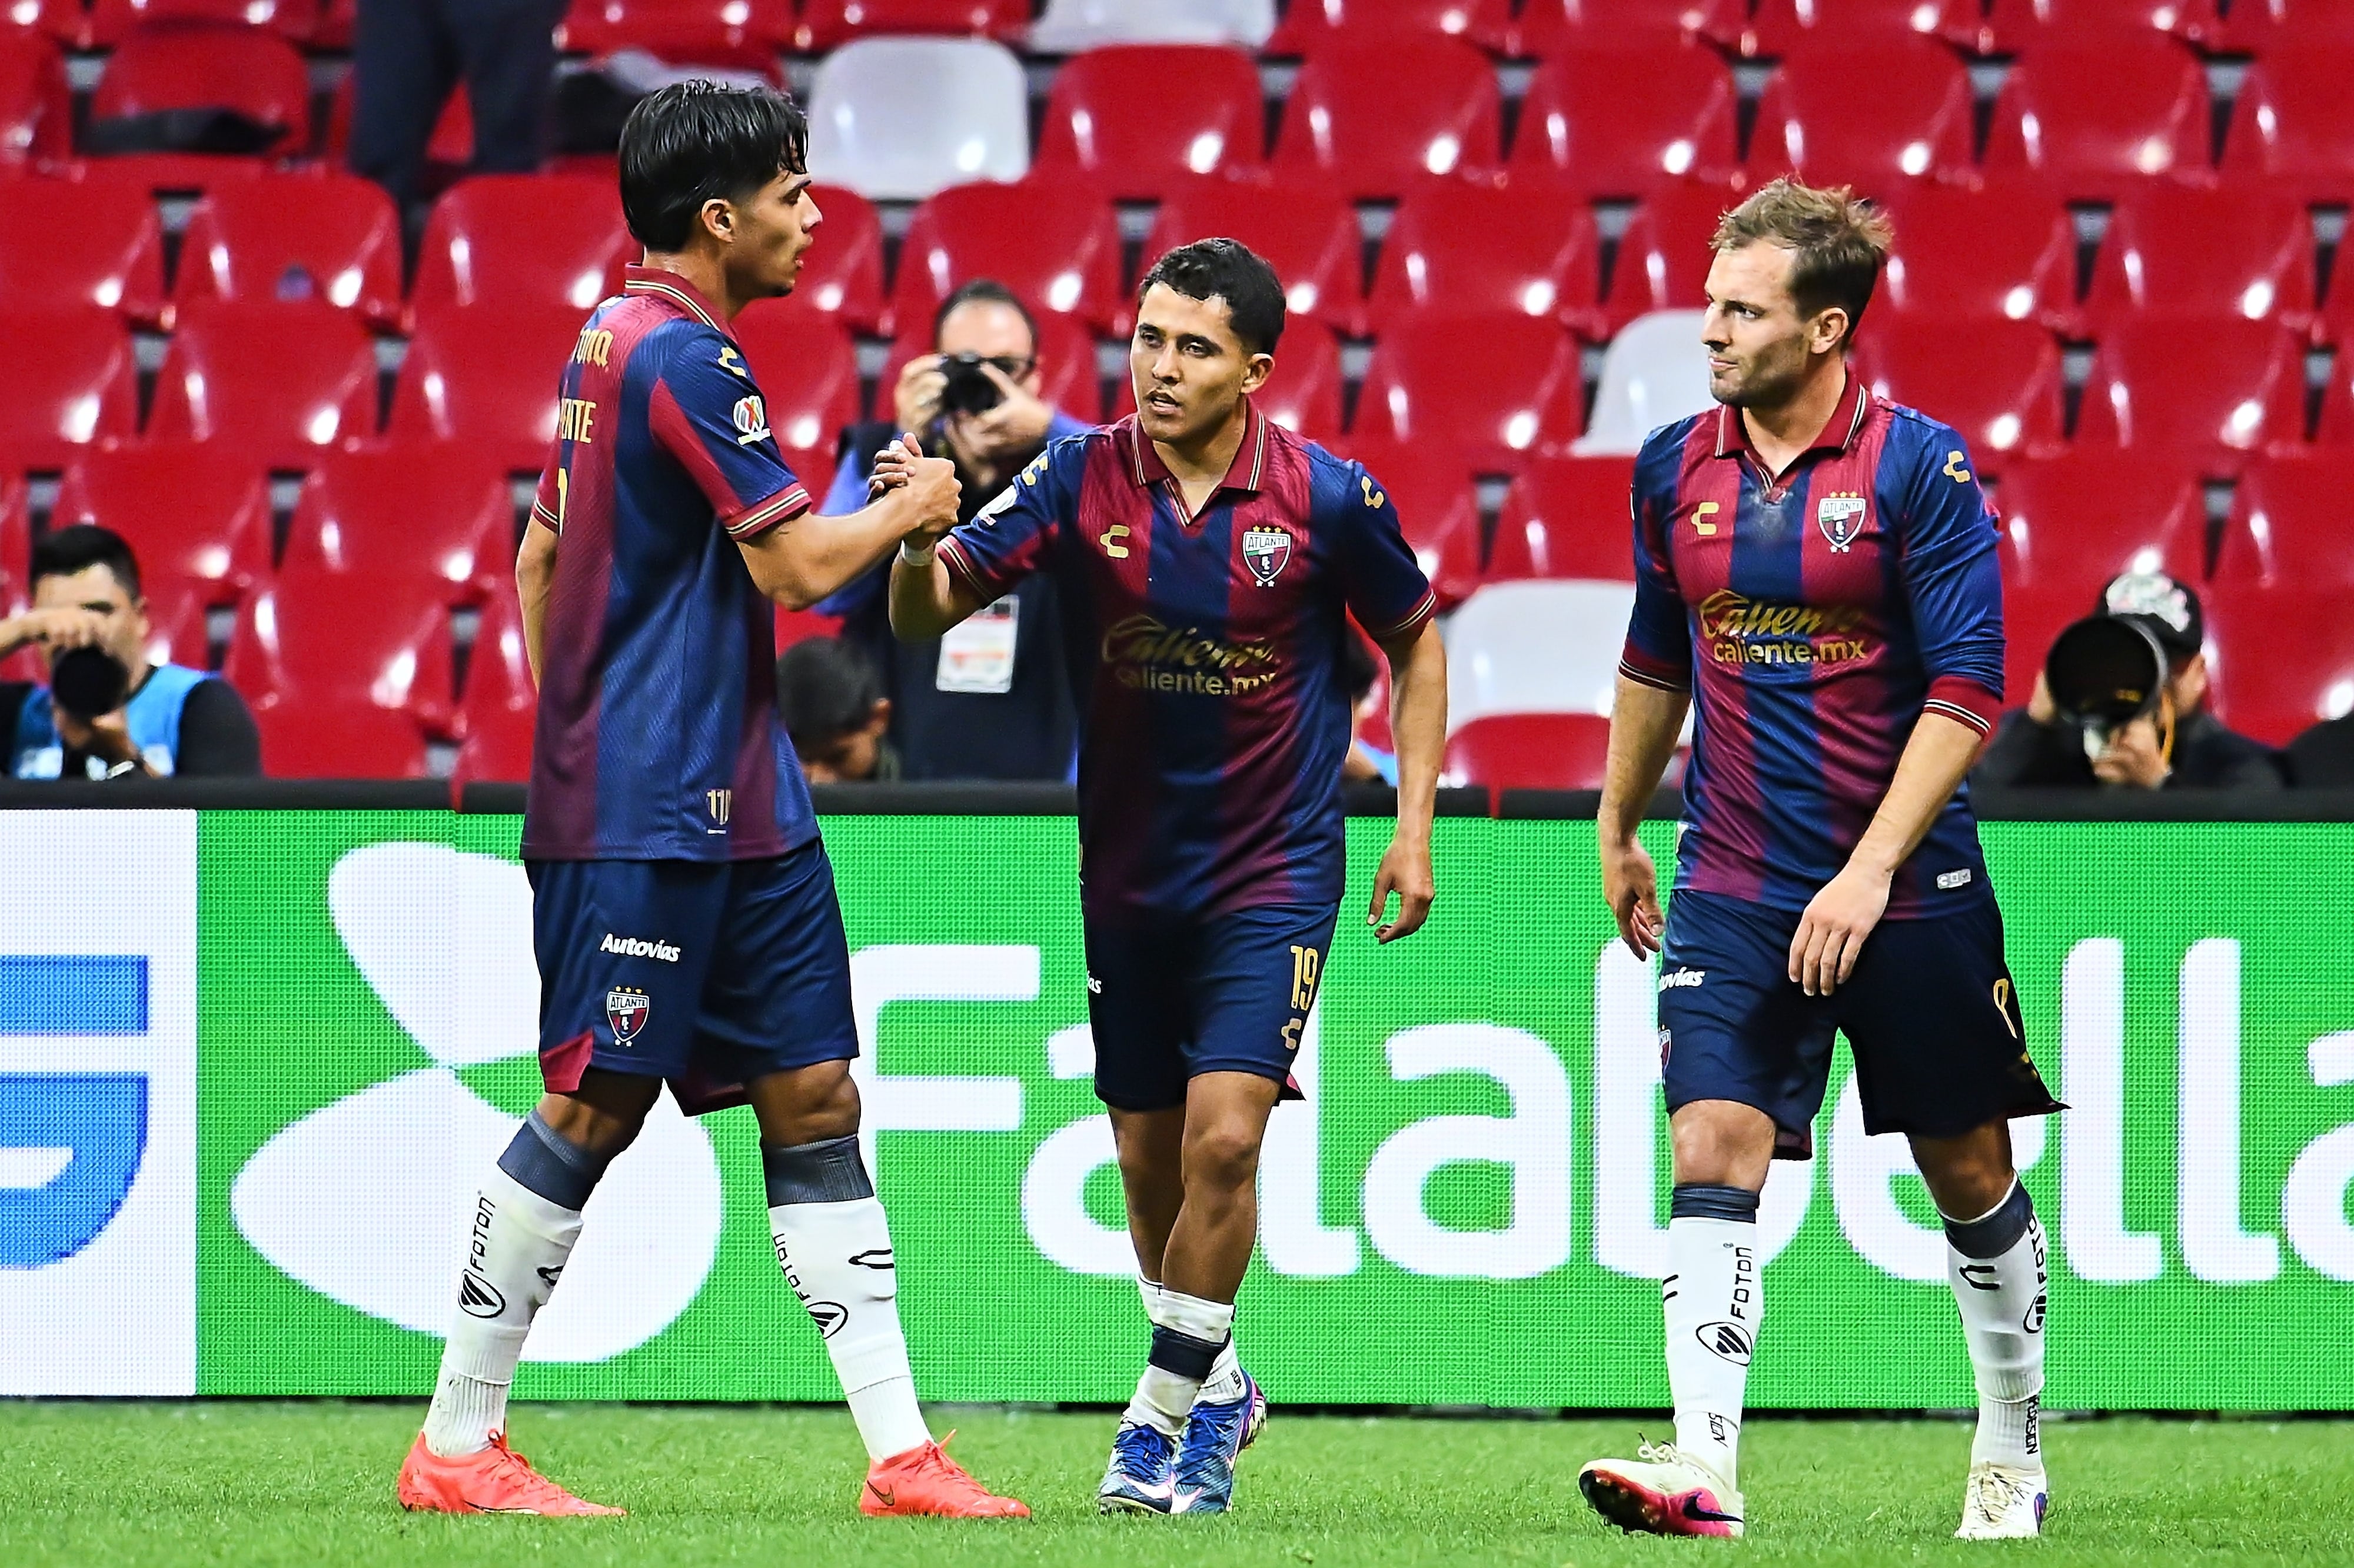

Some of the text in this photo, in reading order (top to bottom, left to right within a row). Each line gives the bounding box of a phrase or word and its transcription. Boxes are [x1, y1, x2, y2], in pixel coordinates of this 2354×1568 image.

[1248, 536, 1286, 550] ATLANTE
[1713, 638, 1868, 665] caliente.mx
[600, 933, 681, 962] Autovías
[1290, 944, 1319, 1011] 19
[1658, 966, 1705, 992] ovías
[470, 1196, 496, 1273] FOTON
[772, 1233, 812, 1302] FOTON
[2027, 1214, 2047, 1284] FOTO
[1730, 1247, 1753, 1321] FOTON
